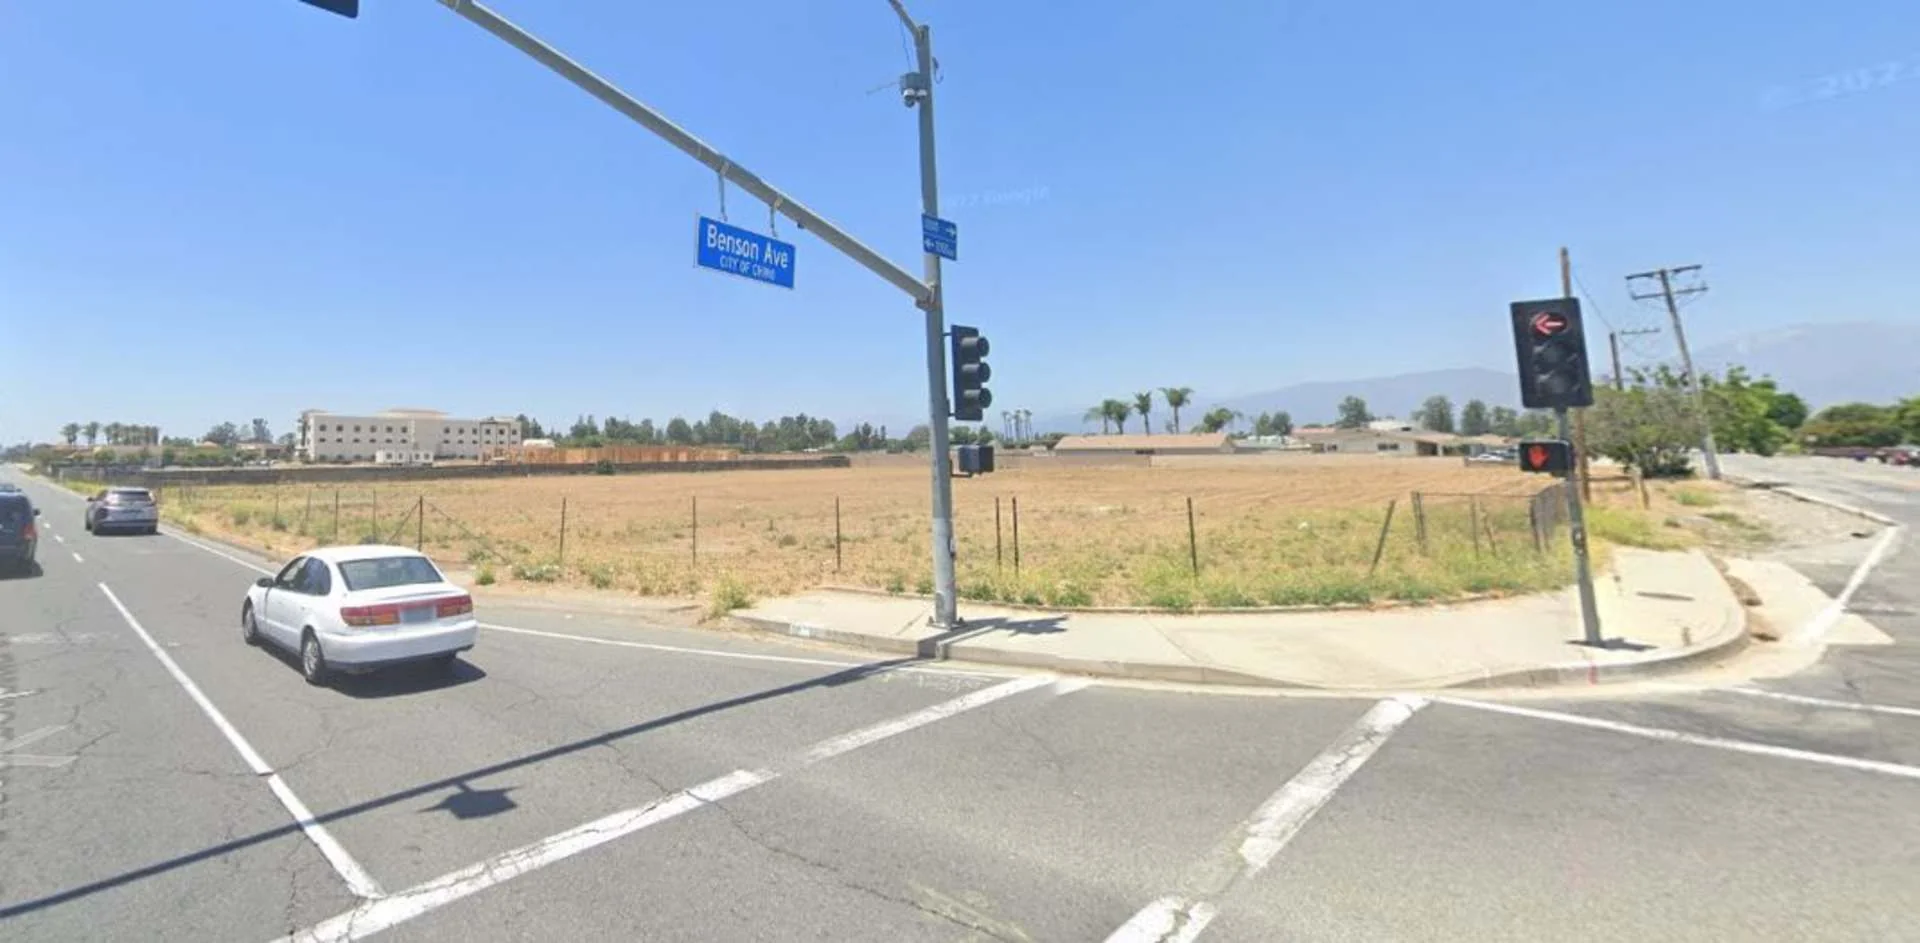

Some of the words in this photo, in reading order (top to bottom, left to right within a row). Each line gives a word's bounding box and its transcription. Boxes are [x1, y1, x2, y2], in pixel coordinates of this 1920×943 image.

[707, 224, 759, 261] Benson
[764, 242, 788, 268] Ave
[720, 255, 739, 273] CITY
[739, 260, 751, 275] OF
